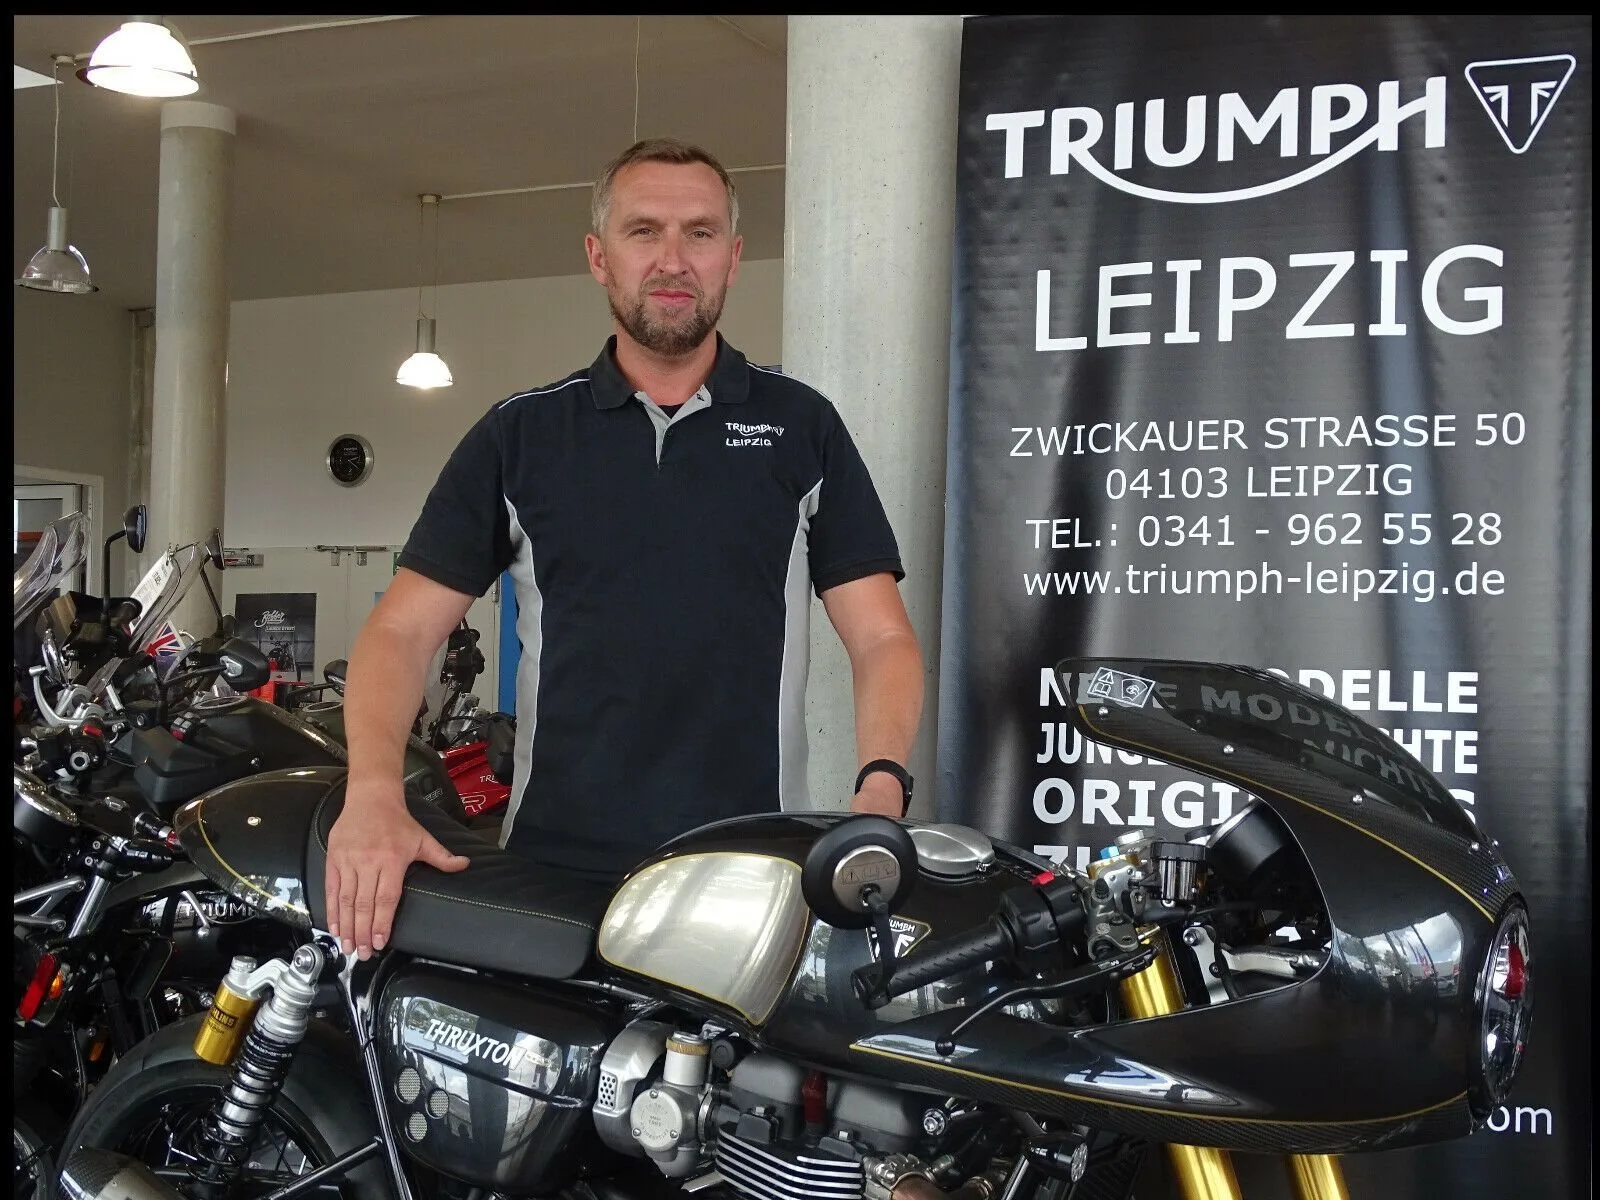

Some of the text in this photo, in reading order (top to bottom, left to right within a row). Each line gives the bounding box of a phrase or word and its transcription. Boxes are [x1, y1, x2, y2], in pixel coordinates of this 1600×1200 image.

[985, 76, 1447, 204] TRIUMPH
[1035, 244, 1504, 352] LEIPZIG
[725, 422, 774, 436] TRIUMPH
[725, 438, 772, 447] LEIPZIG
[1009, 412, 1526, 457] ZWICKAUER STRASSE 50
[1106, 463, 1412, 500] 04103 LEIPZIG
[1025, 518, 1117, 549] TEL.:
[1138, 514, 1235, 547] 0341
[1287, 512, 1363, 546] 962
[1382, 512, 1432, 546] 55
[1451, 512, 1502, 546] 28
[1023, 561, 1505, 603] www.triumph-leipzig.de
[423, 1019, 528, 1070] THRUXTON
